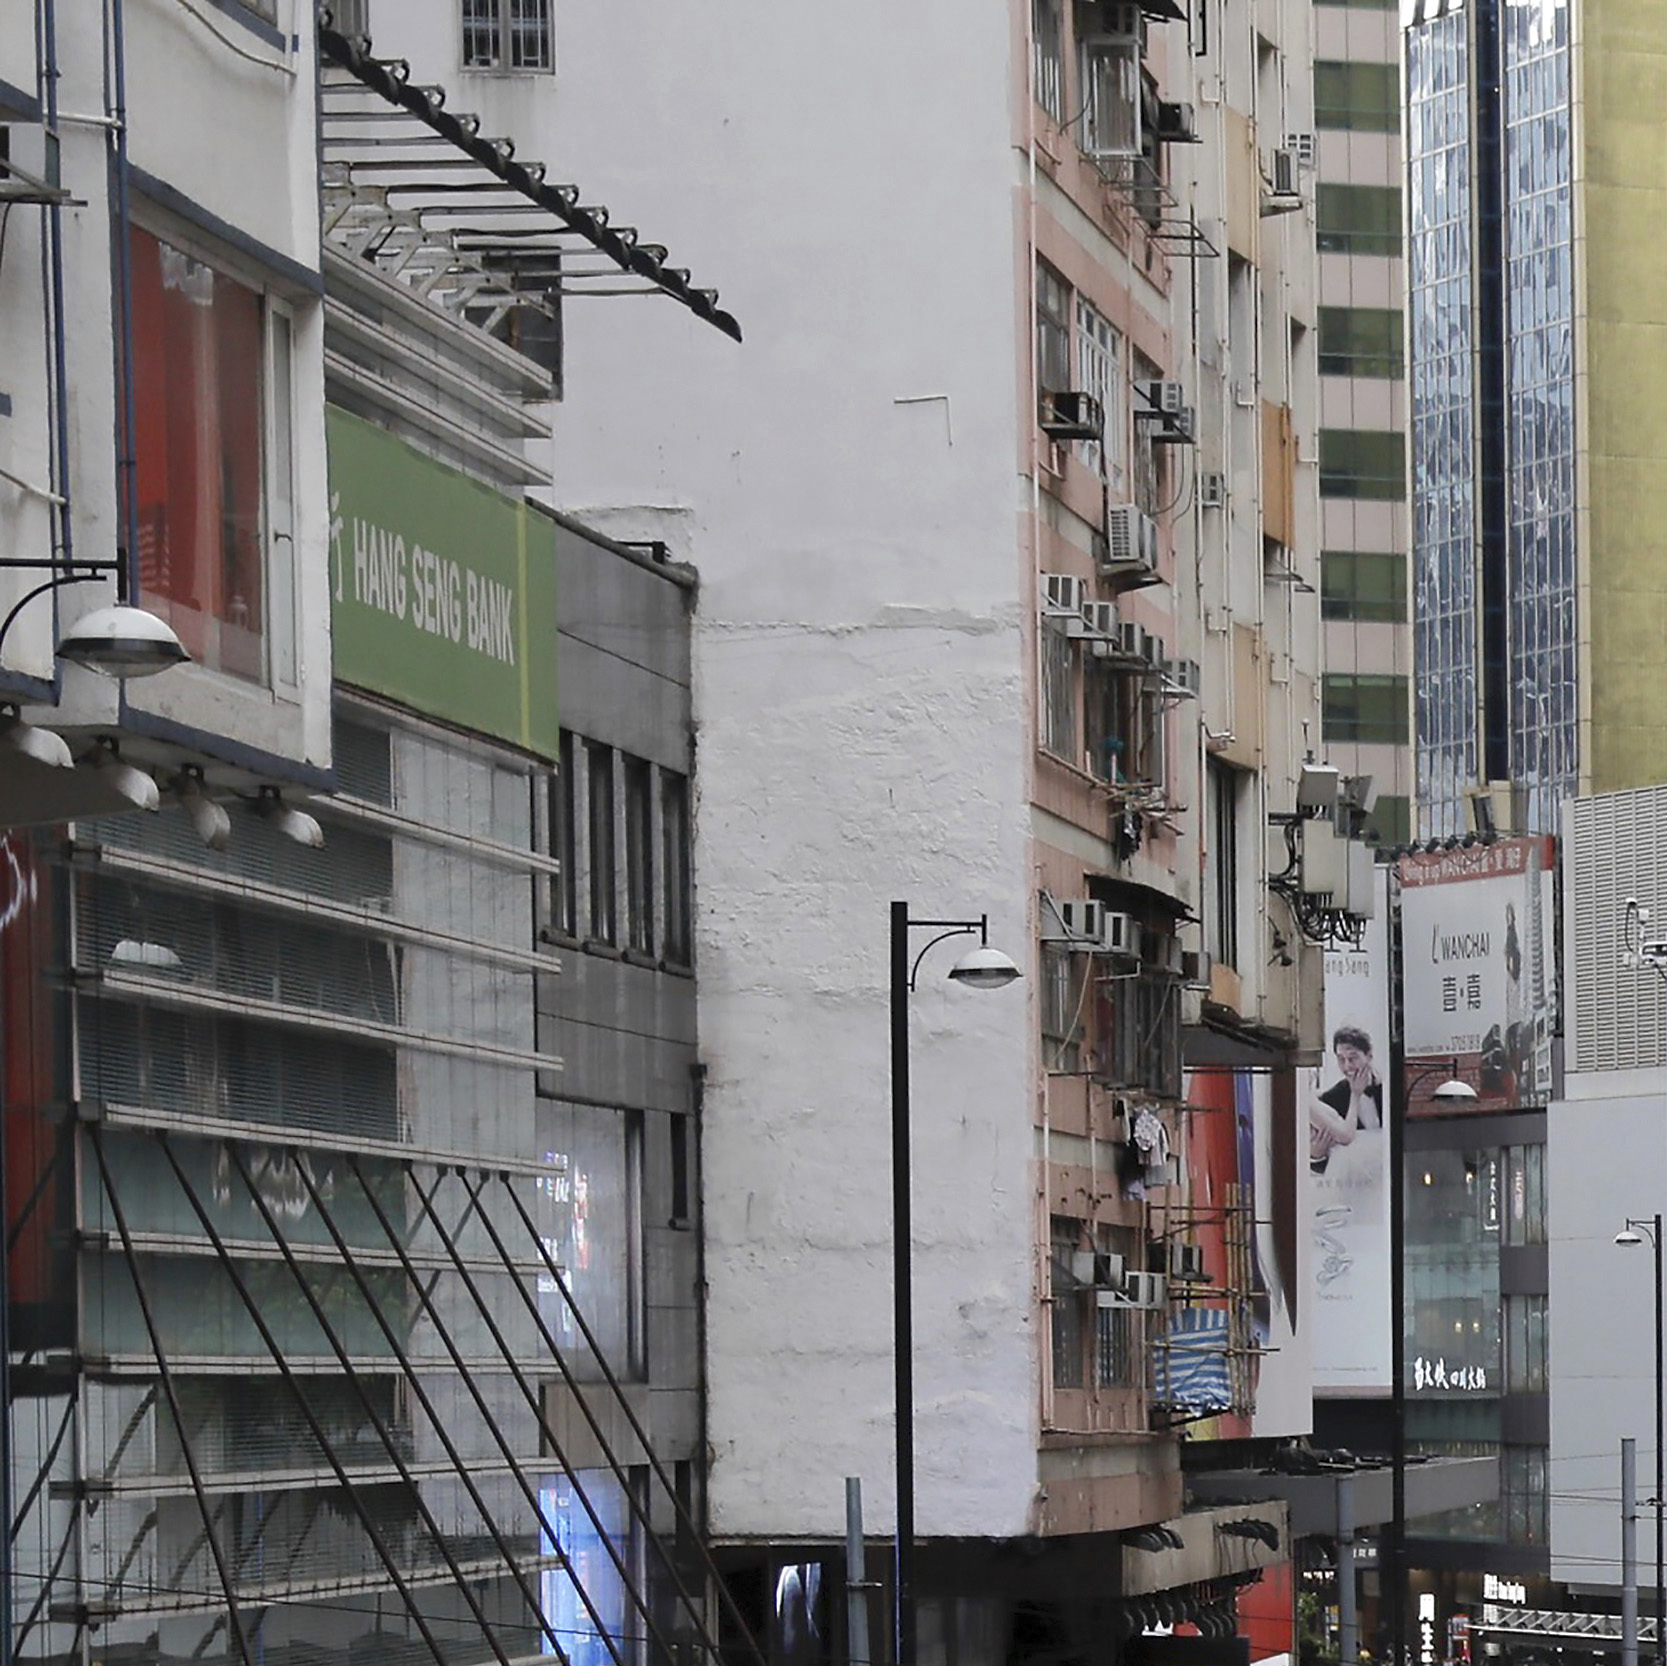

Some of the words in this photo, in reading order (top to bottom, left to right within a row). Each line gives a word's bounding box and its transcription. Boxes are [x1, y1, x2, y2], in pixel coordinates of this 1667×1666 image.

[353, 516, 406, 621] HANG
[411, 544, 461, 643] SENG
[466, 567, 514, 667] BANK
